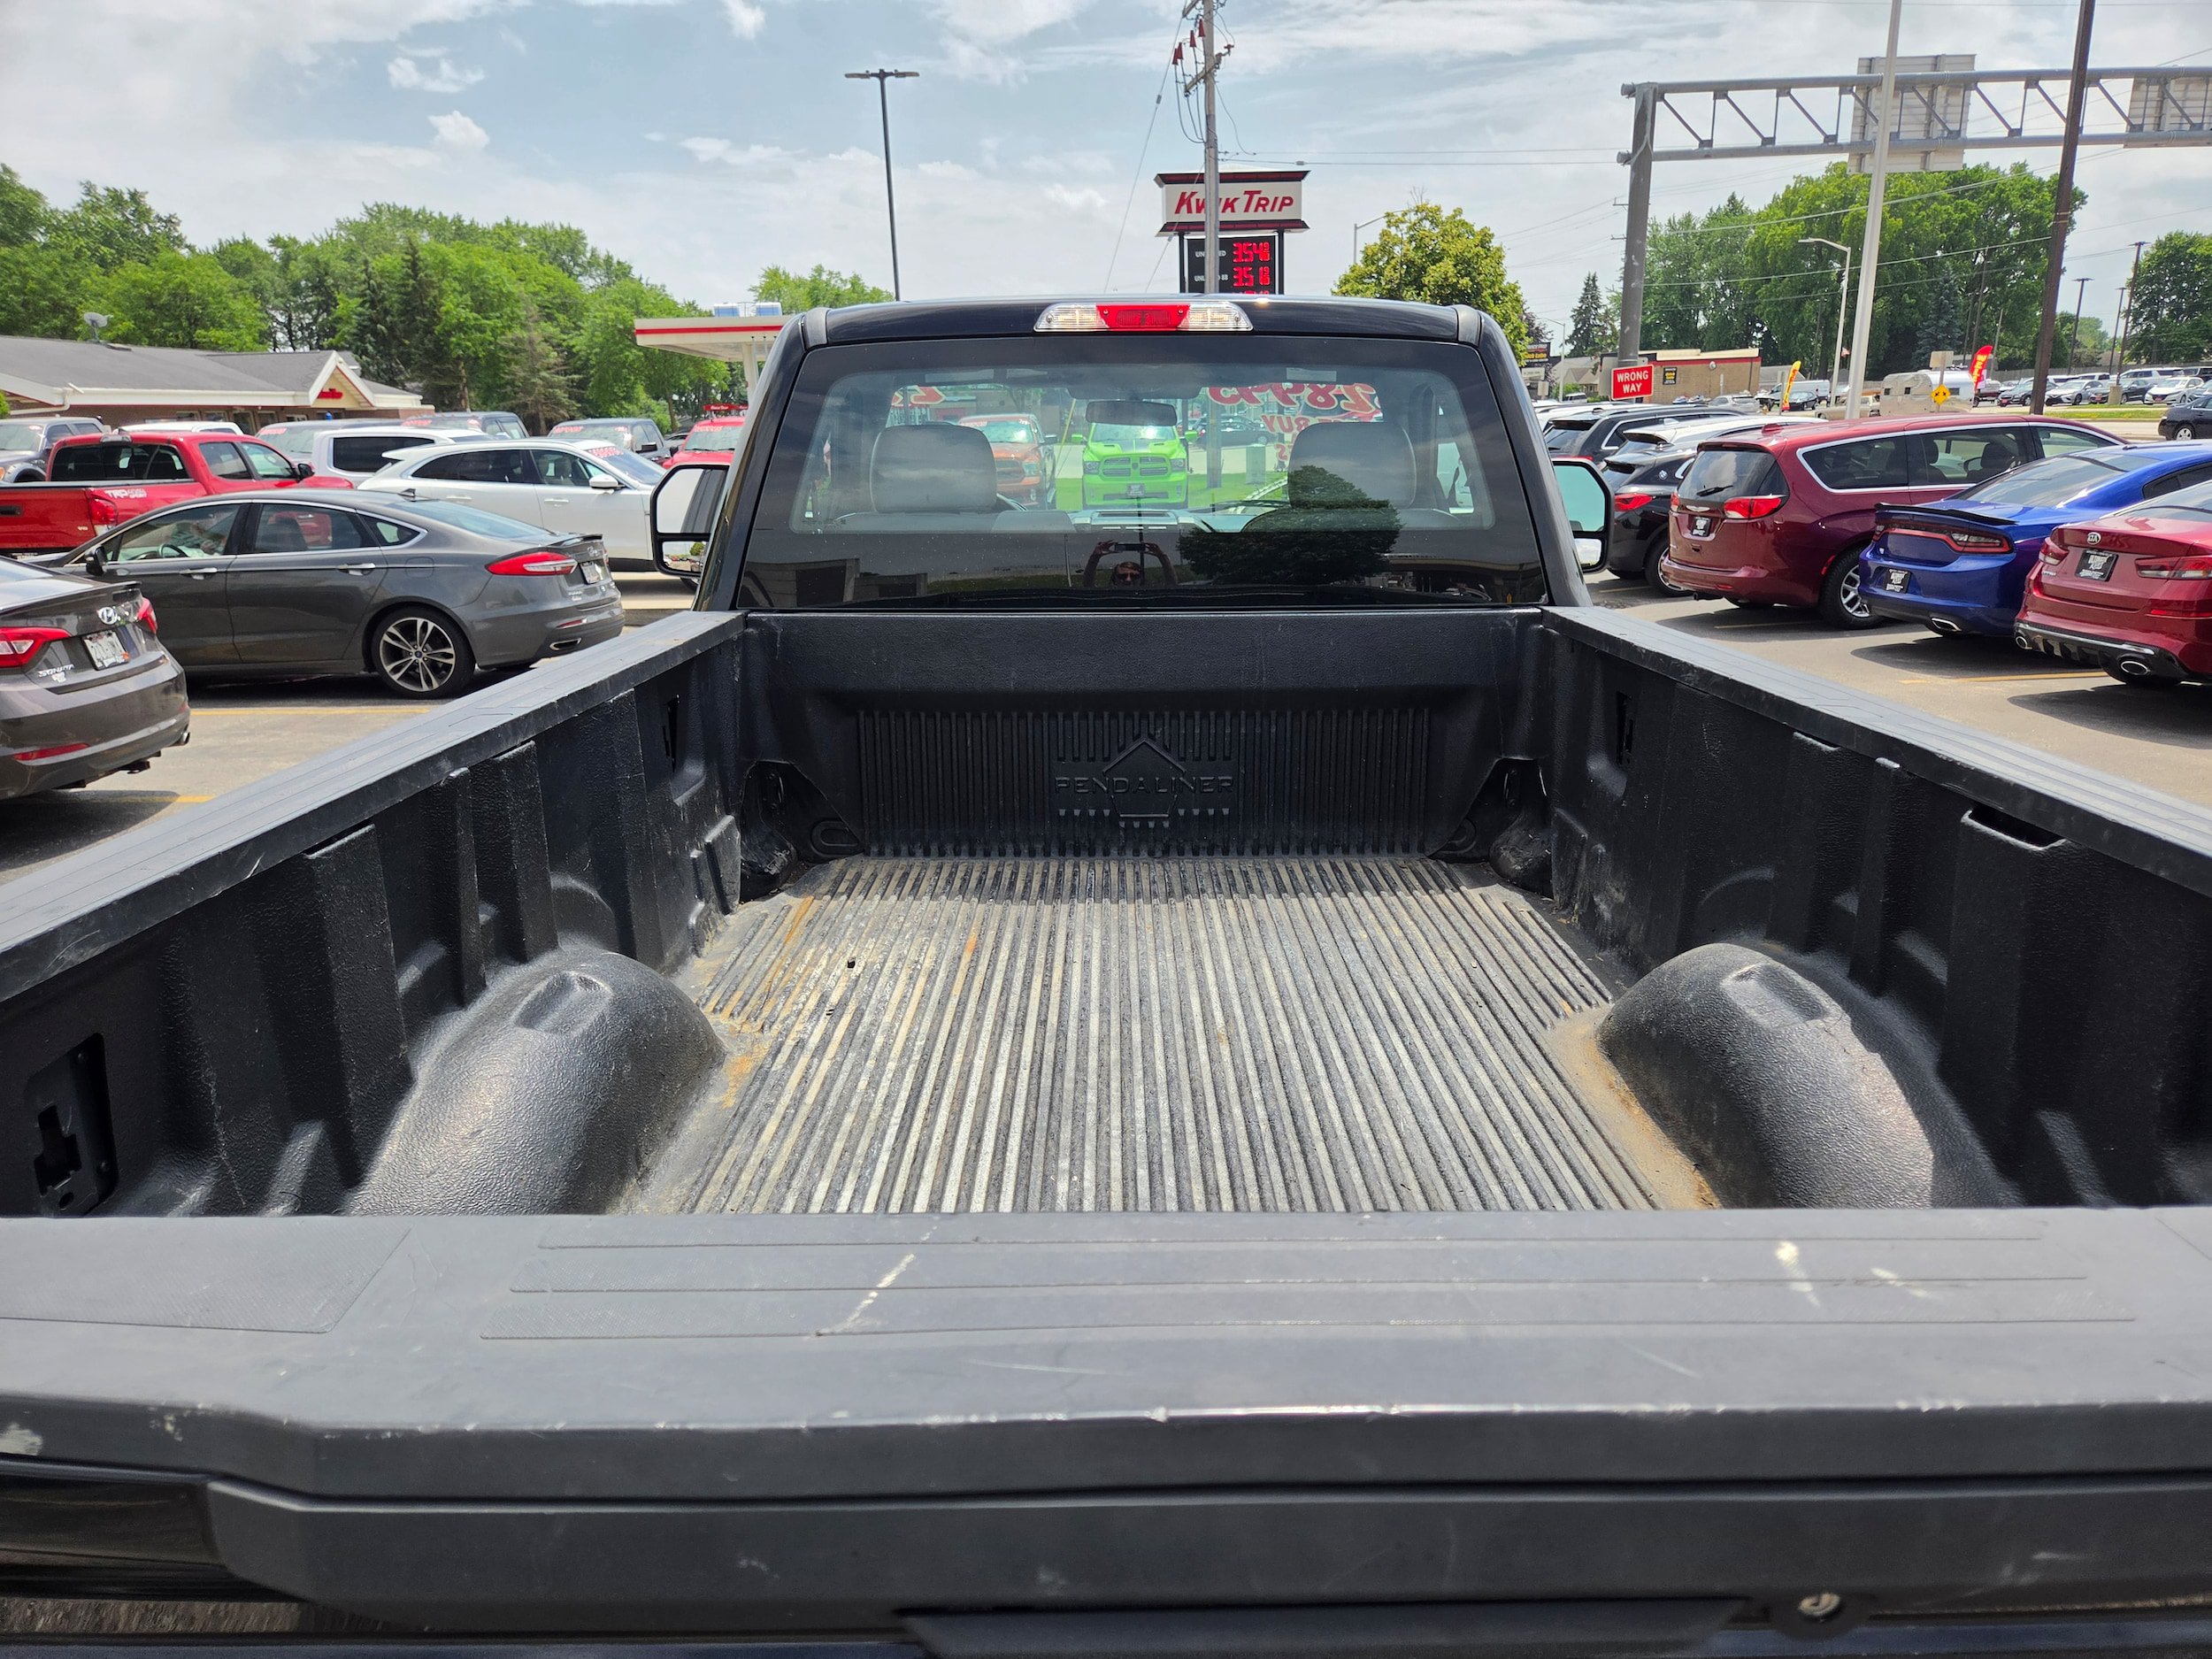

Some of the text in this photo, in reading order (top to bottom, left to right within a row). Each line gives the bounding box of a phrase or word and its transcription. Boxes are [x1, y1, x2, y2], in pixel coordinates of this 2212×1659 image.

[1243, 190, 1294, 212] TRIP
[1617, 370, 1648, 383] WRONG
[1623, 382, 1642, 394] WAY
[1054, 776, 1234, 794] PENDALINER
